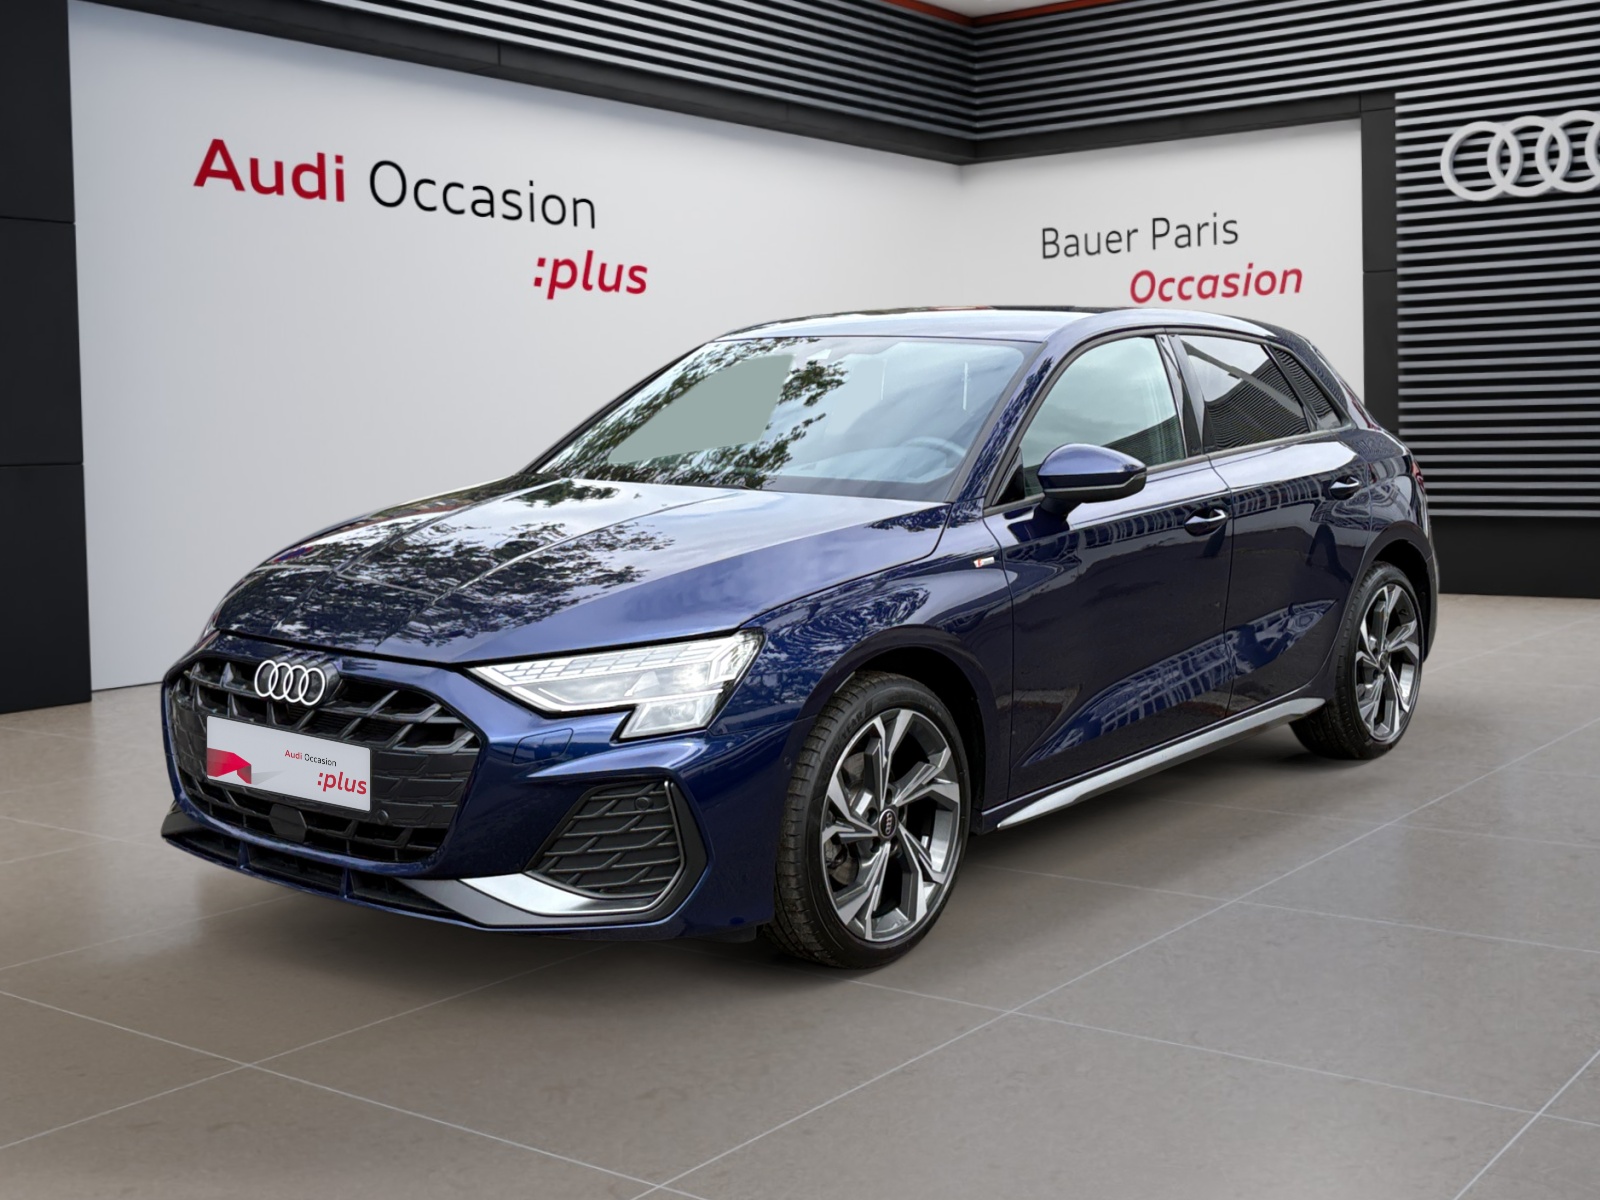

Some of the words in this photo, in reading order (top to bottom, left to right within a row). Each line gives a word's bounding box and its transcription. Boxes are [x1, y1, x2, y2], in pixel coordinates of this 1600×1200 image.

[194, 138, 345, 202] Audi
[369, 160, 596, 229] Occasion
[1041, 227, 1139, 259] Bauer
[1151, 212, 1239, 250] Paris
[533, 250, 648, 300] :plus
[1130, 262, 1303, 304] Occasion
[284, 749, 303, 760] Audi
[304, 753, 337, 767] Occasion
[317, 771, 367, 795] :plus
